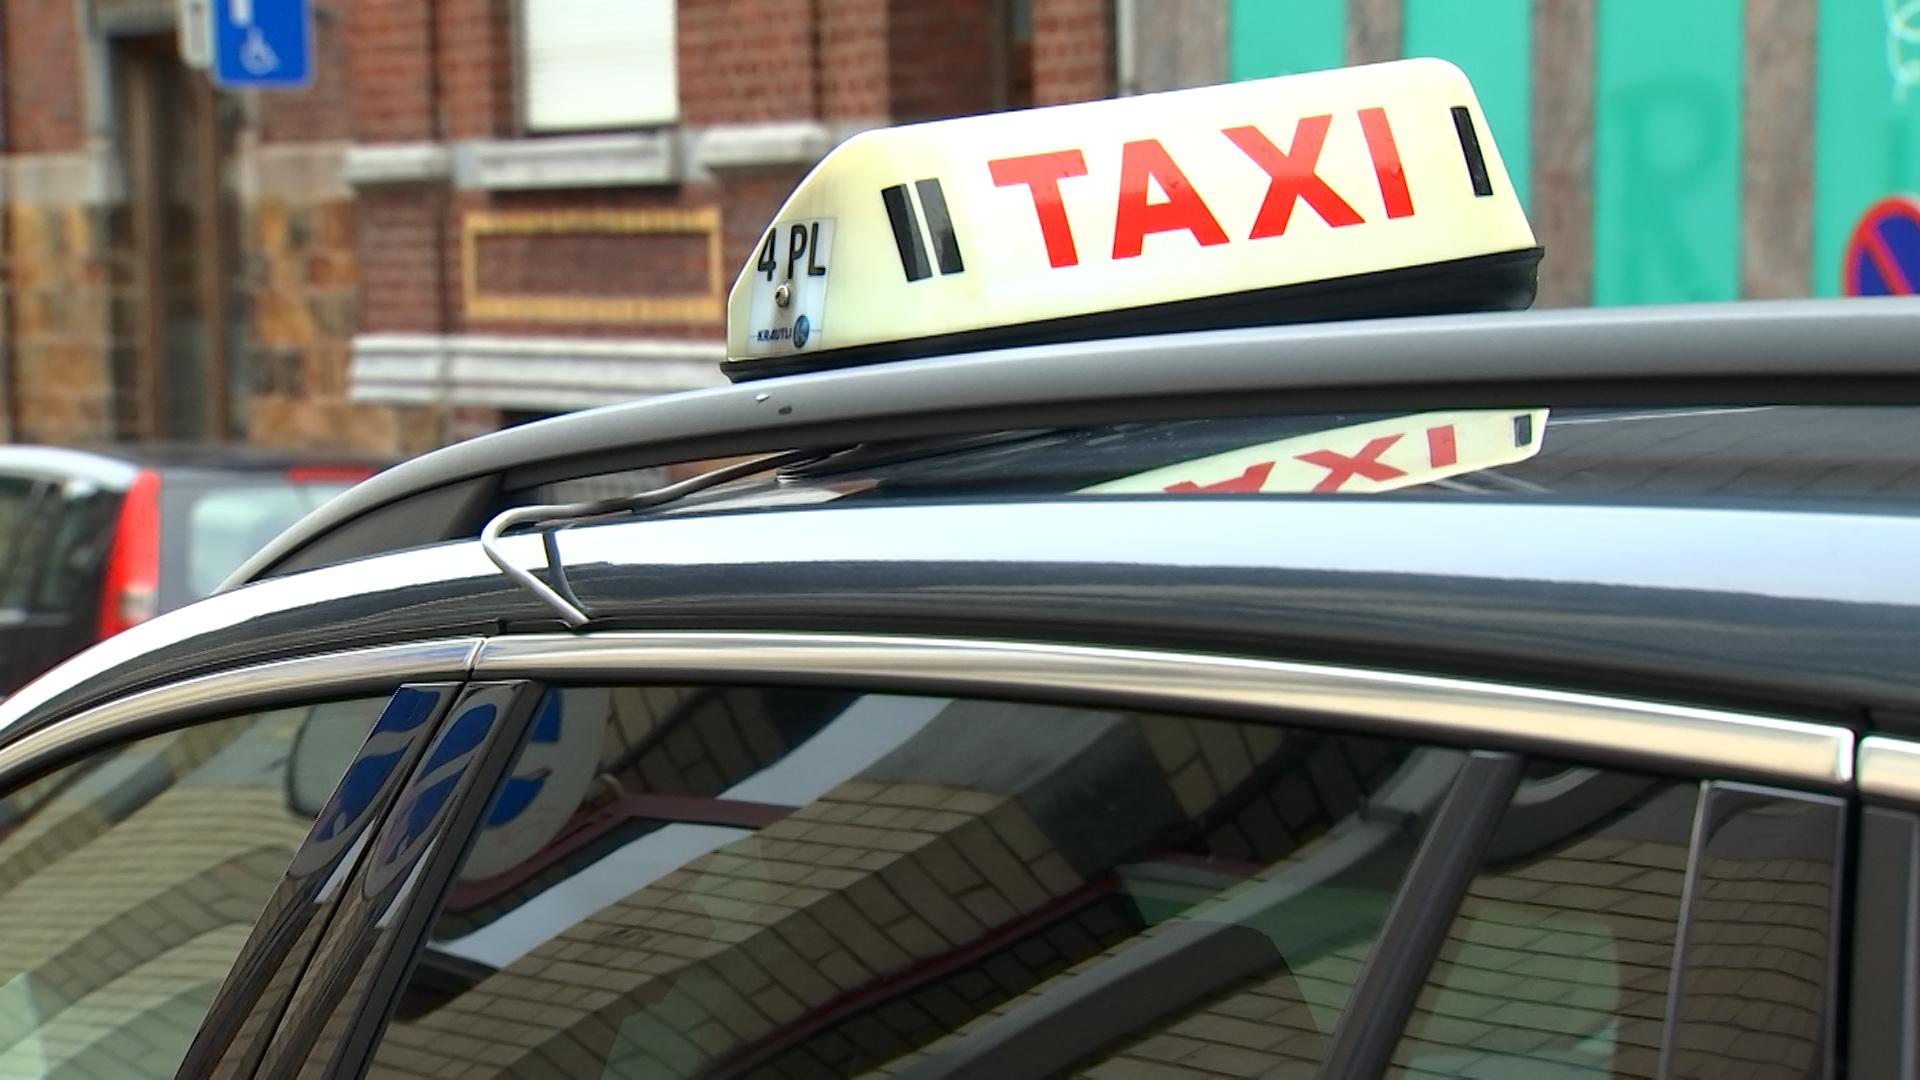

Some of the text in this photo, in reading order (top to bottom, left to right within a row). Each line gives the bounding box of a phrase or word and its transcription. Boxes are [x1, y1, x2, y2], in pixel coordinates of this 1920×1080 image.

[987, 107, 1415, 269] TAXI
[757, 221, 826, 282] 4 PL
